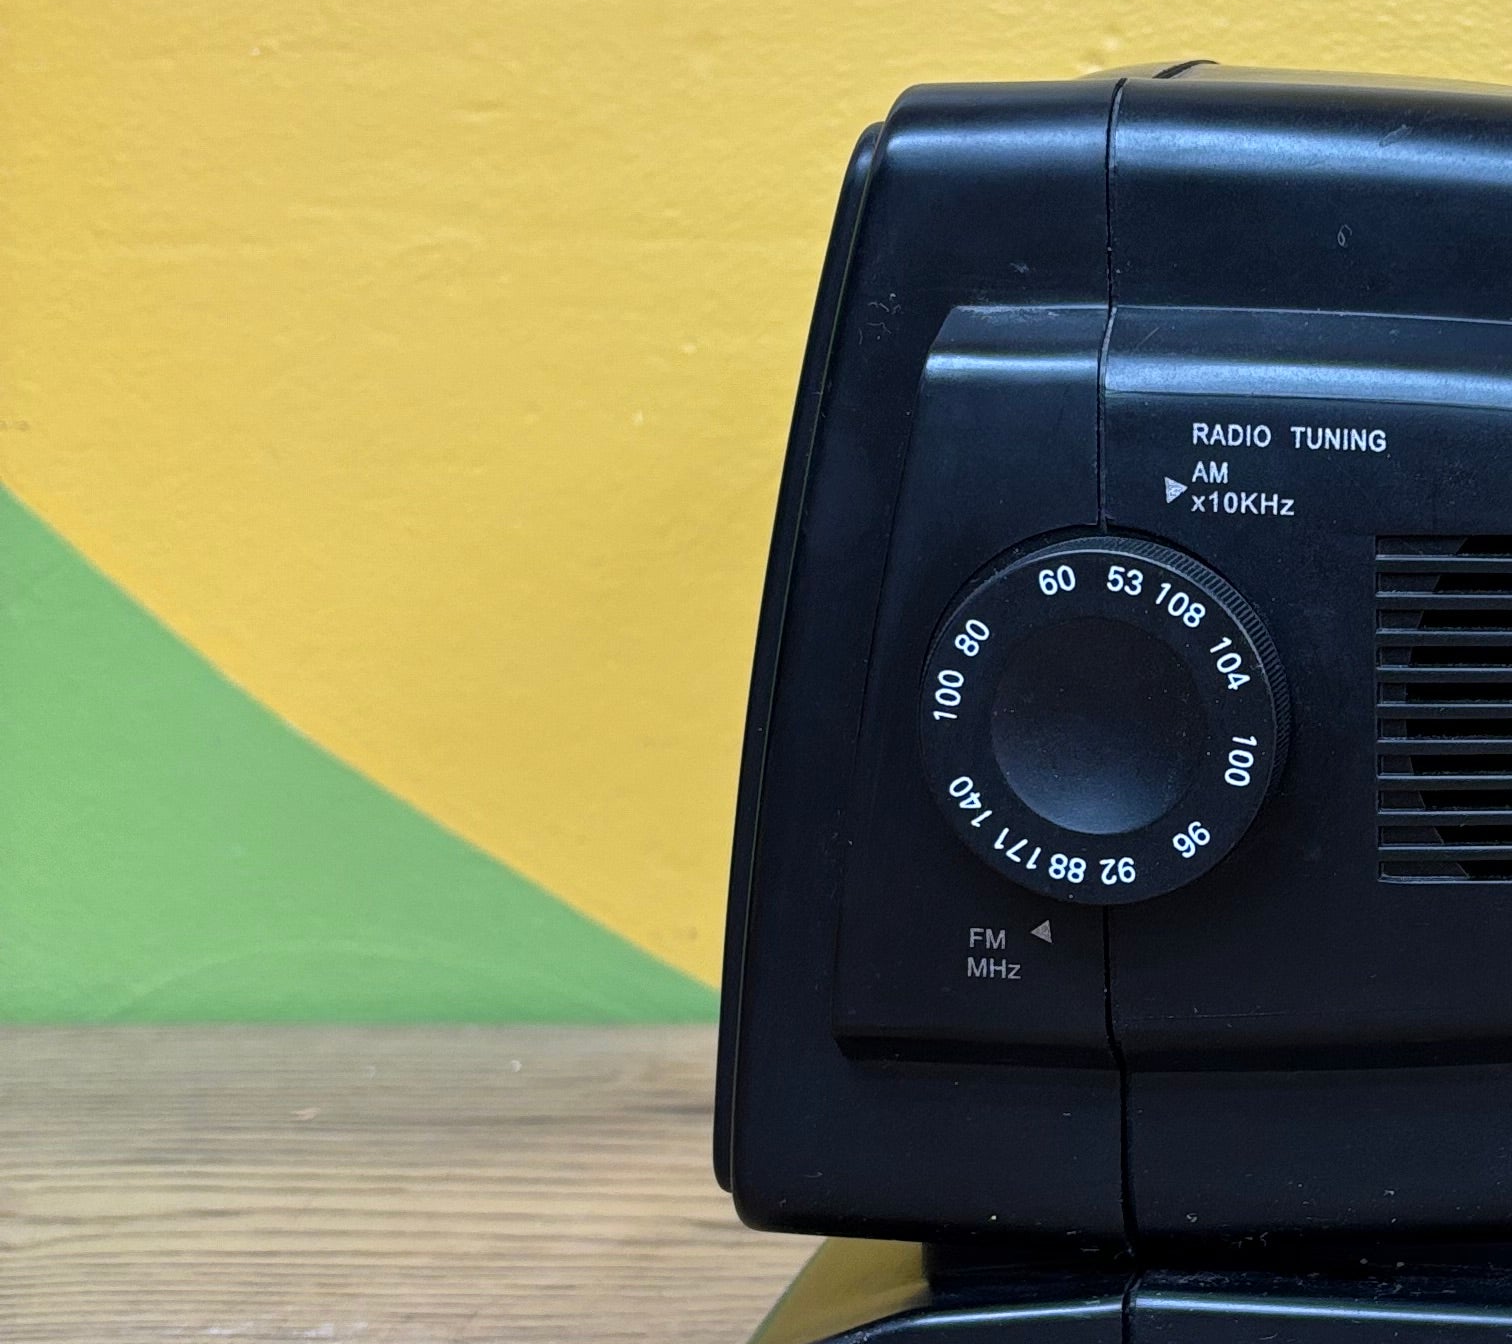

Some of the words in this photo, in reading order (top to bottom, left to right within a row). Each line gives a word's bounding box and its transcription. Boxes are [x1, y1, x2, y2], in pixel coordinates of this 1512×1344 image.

[1192, 422, 1272, 448] RADIO
[1290, 426, 1387, 453] TUNING
[1191, 460, 1229, 484] AM
[1190, 490, 1295, 516] x10KHz
[1038, 564, 1076, 596] 60
[1106, 565, 1144, 596] 53
[1155, 582, 1206, 628] 108
[954, 618, 990, 657] 80
[1209, 636, 1251, 691] 104
[932, 669, 965, 721] 100
[1223, 735, 1258, 787] 100
[948, 775, 993, 828] 140
[993, 827, 1042, 870] 171
[1172, 820, 1211, 859] 96
[1047, 853, 1087, 884] 88
[1098, 856, 1136, 886] 92
[969, 927, 1006, 950] FM
[967, 956, 1021, 979] MHz
